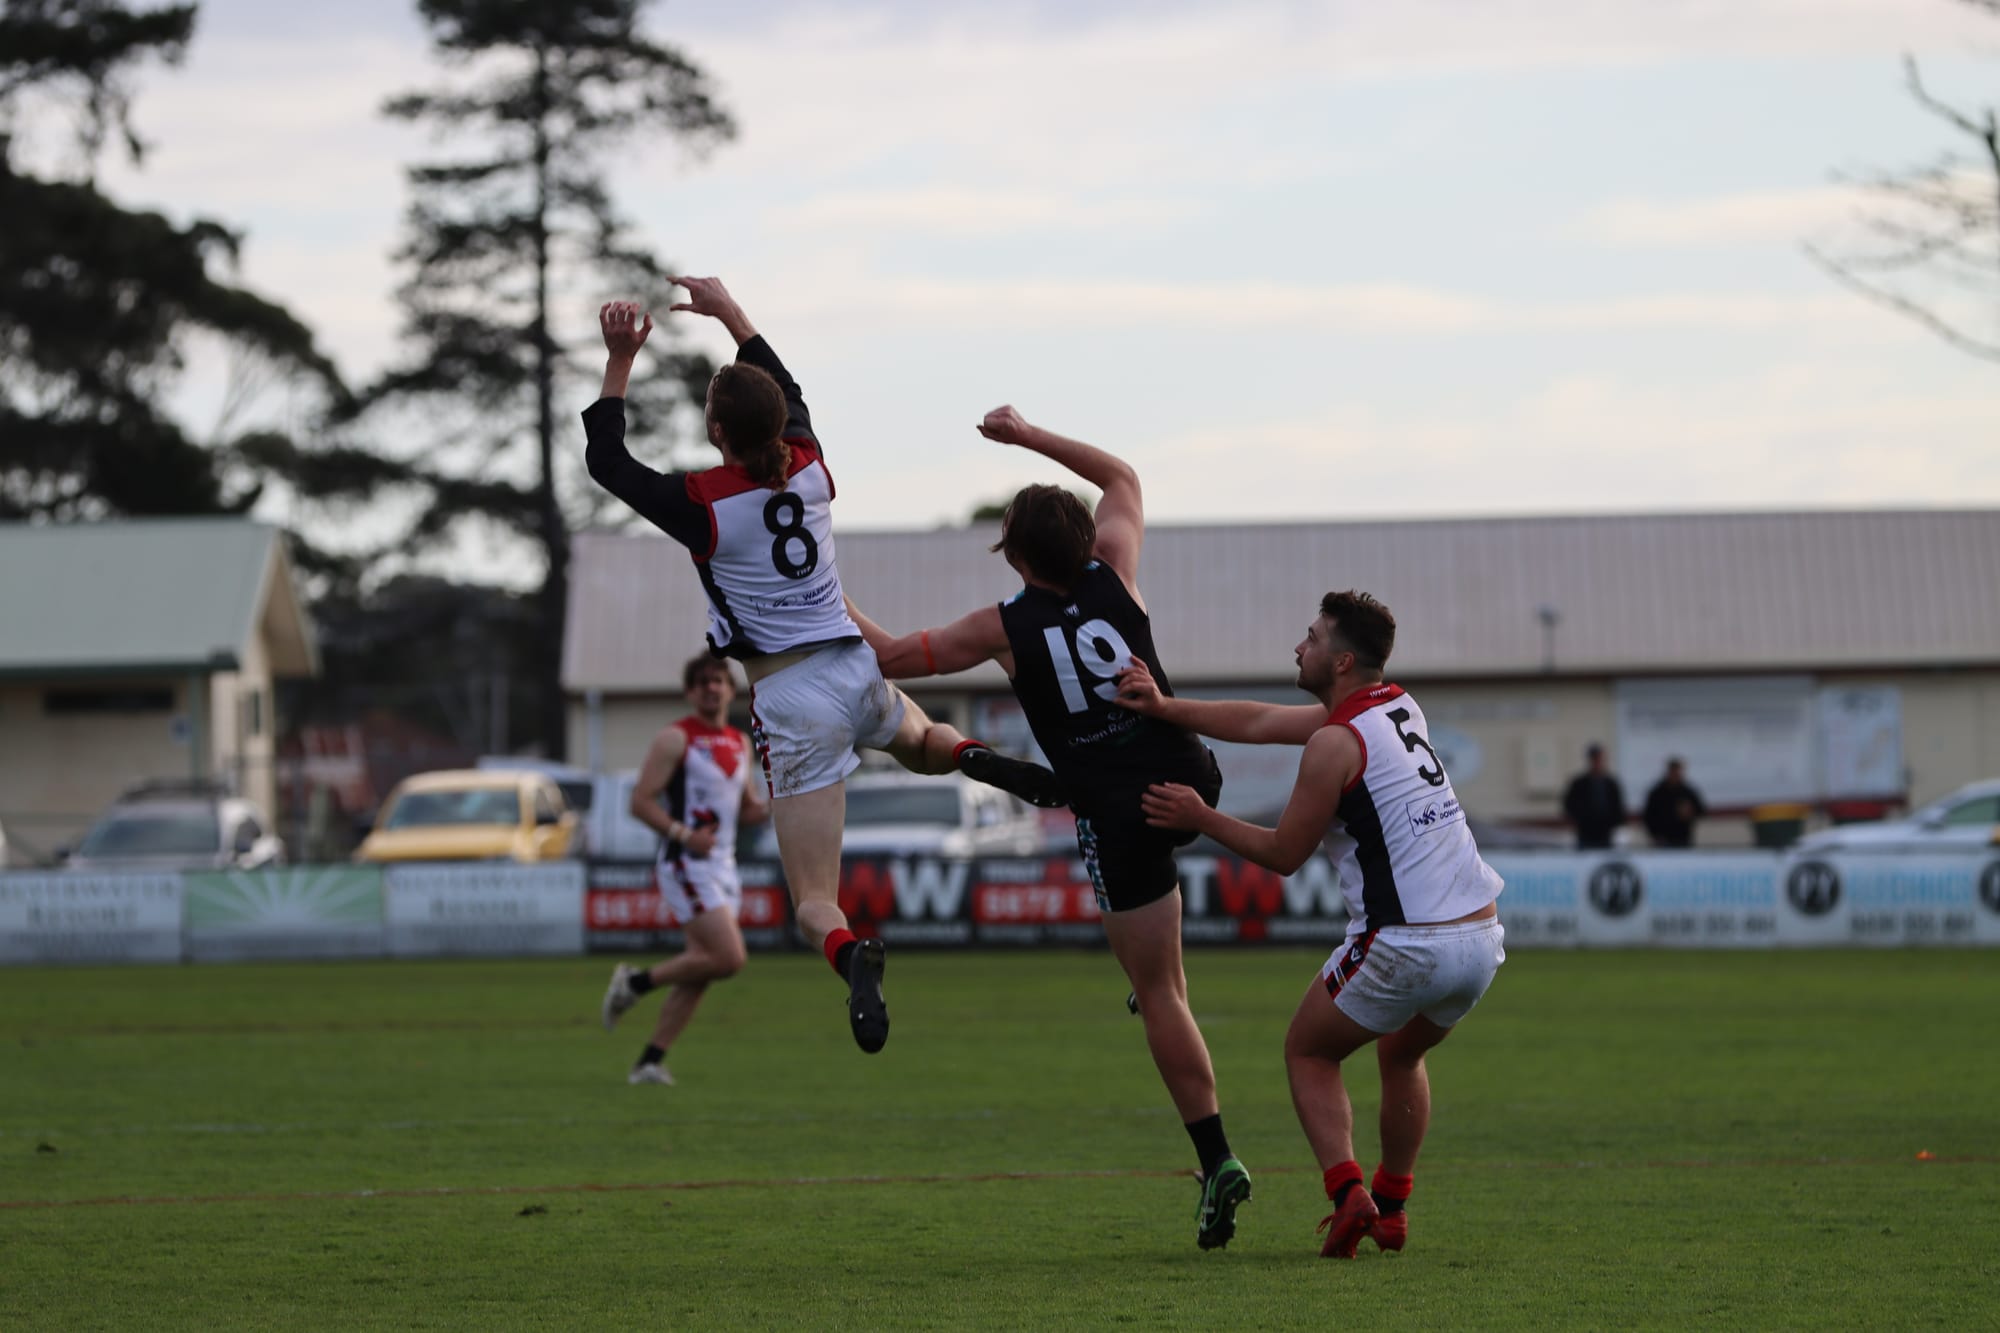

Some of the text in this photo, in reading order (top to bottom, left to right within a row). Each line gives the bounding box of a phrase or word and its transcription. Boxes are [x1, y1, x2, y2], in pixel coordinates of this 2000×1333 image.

[763, 492, 818, 579] 8
[1043, 618, 1134, 714] 19
[1386, 707, 1445, 787] 5
[838, 860, 969, 919] WW
